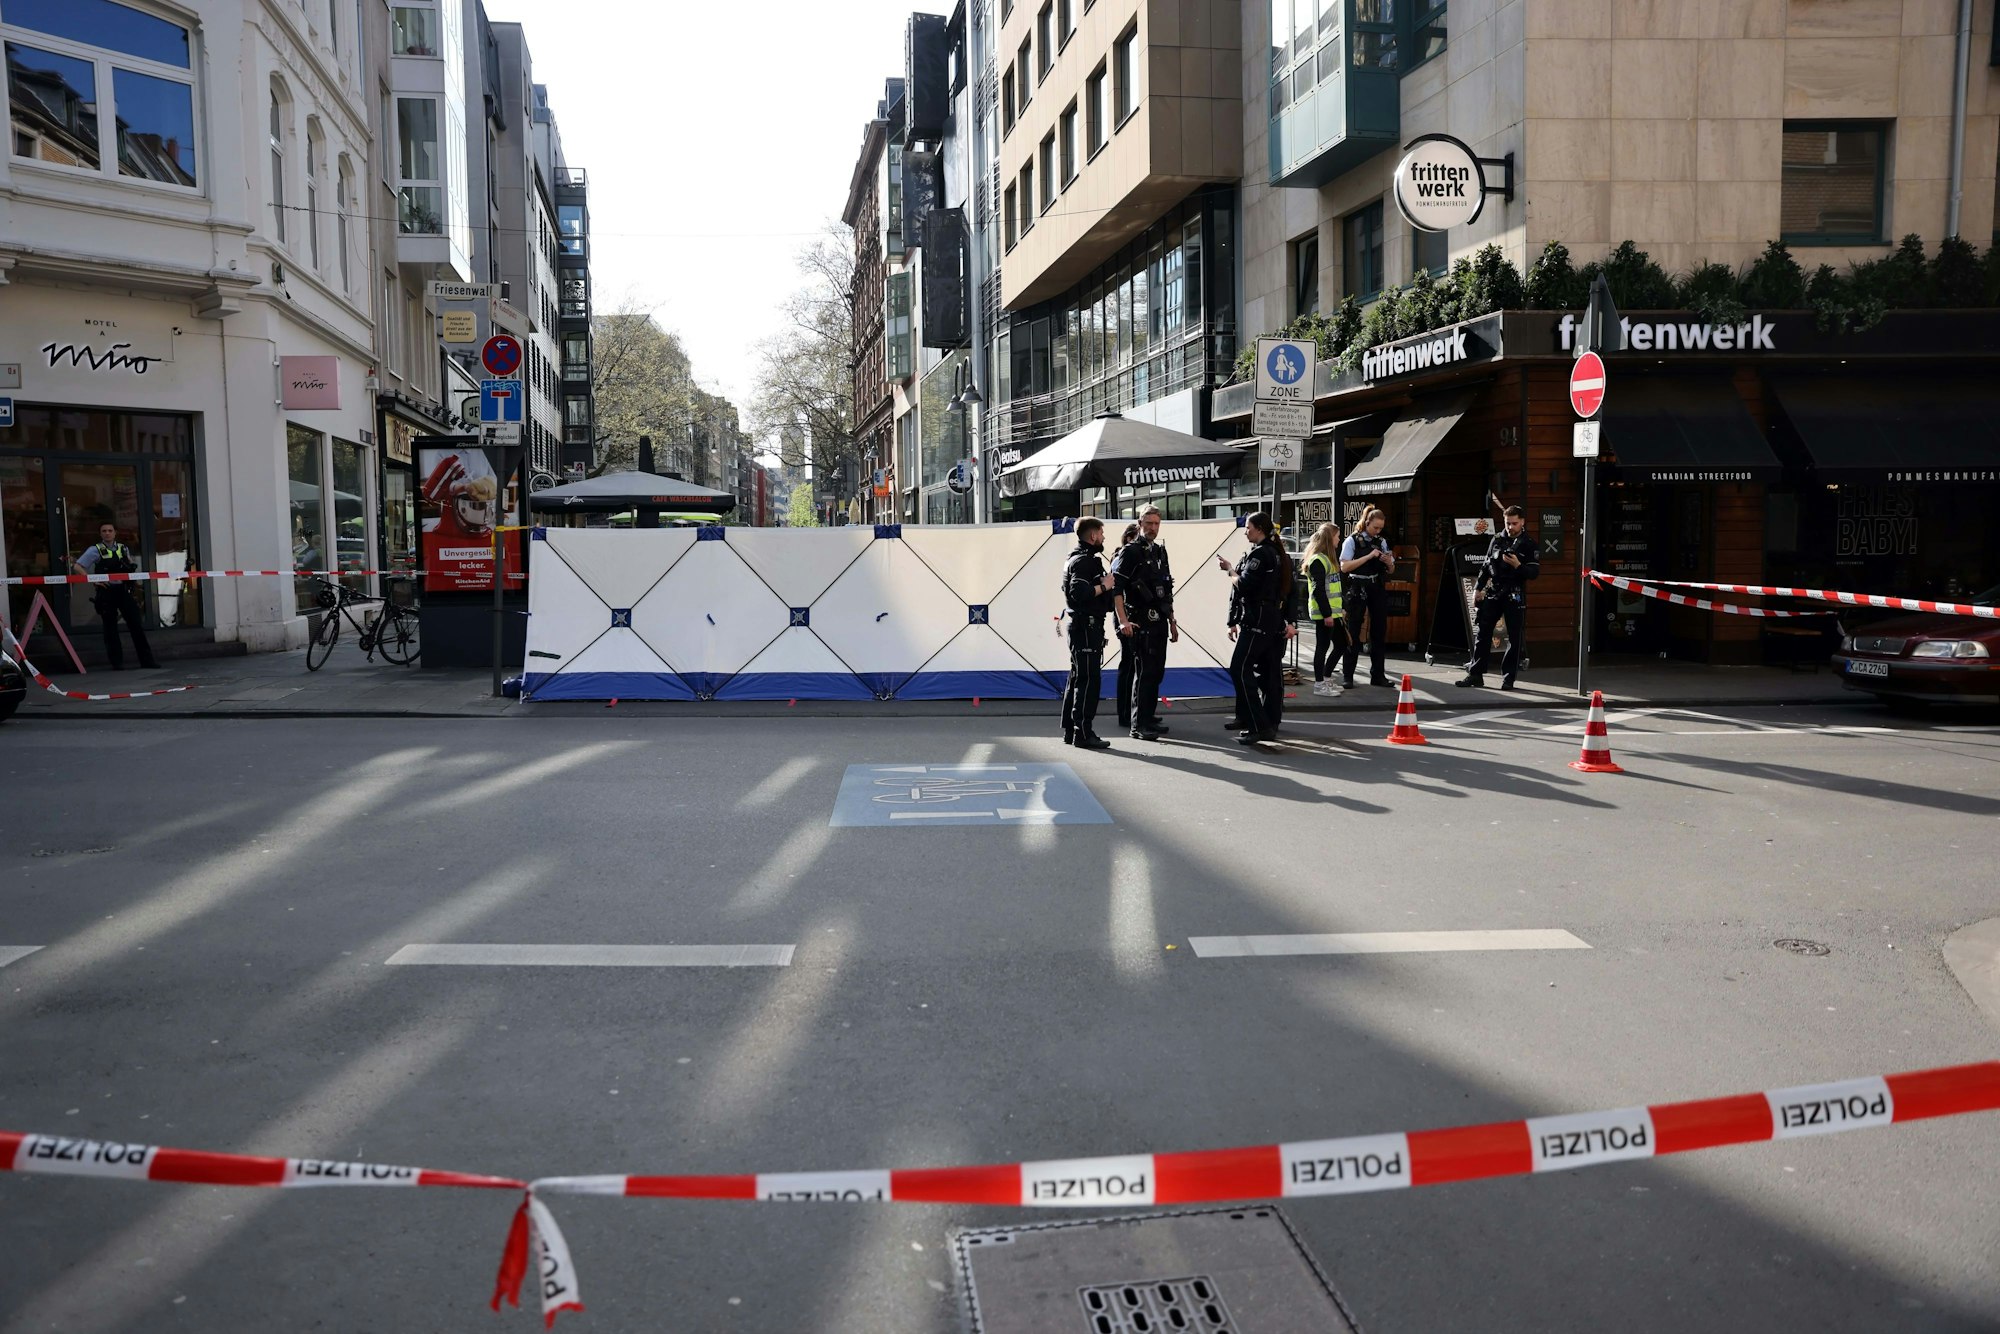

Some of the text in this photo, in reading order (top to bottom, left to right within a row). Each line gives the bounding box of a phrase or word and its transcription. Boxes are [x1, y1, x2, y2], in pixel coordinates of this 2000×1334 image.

[1410, 162, 1469, 181] fritten
[1417, 178, 1465, 197] werk
[434, 283, 492, 297] Friesenwall
[85, 319, 118, 328] MOTEL
[1362, 326, 1468, 381] frittenwerk
[1270, 386, 1300, 398] ZONE
[1499, 426, 1518, 447] 94
[1124, 462, 1220, 485] frittenwerk
[1274, 460, 1288, 468] frei
[1651, 472, 1752, 480] CANADIAN STREETFOOD
[1888, 472, 2000, 480] POMMESMANUFA
[1836, 518, 1919, 556] BABY!
[459, 561, 486, 569] lecker.
[1616, 563, 1649, 571] SALAT-BOWLS
[1868, 663, 1887, 675] 2760
[1781, 1092, 1887, 1128] POLIZEI
[28, 1135, 146, 1165] POLIZEI
[1541, 1124, 1647, 1158] POLIZEI
[1291, 1153, 1403, 1183] POLIZEI
[1031, 1174, 1146, 1199] POLIZEI
